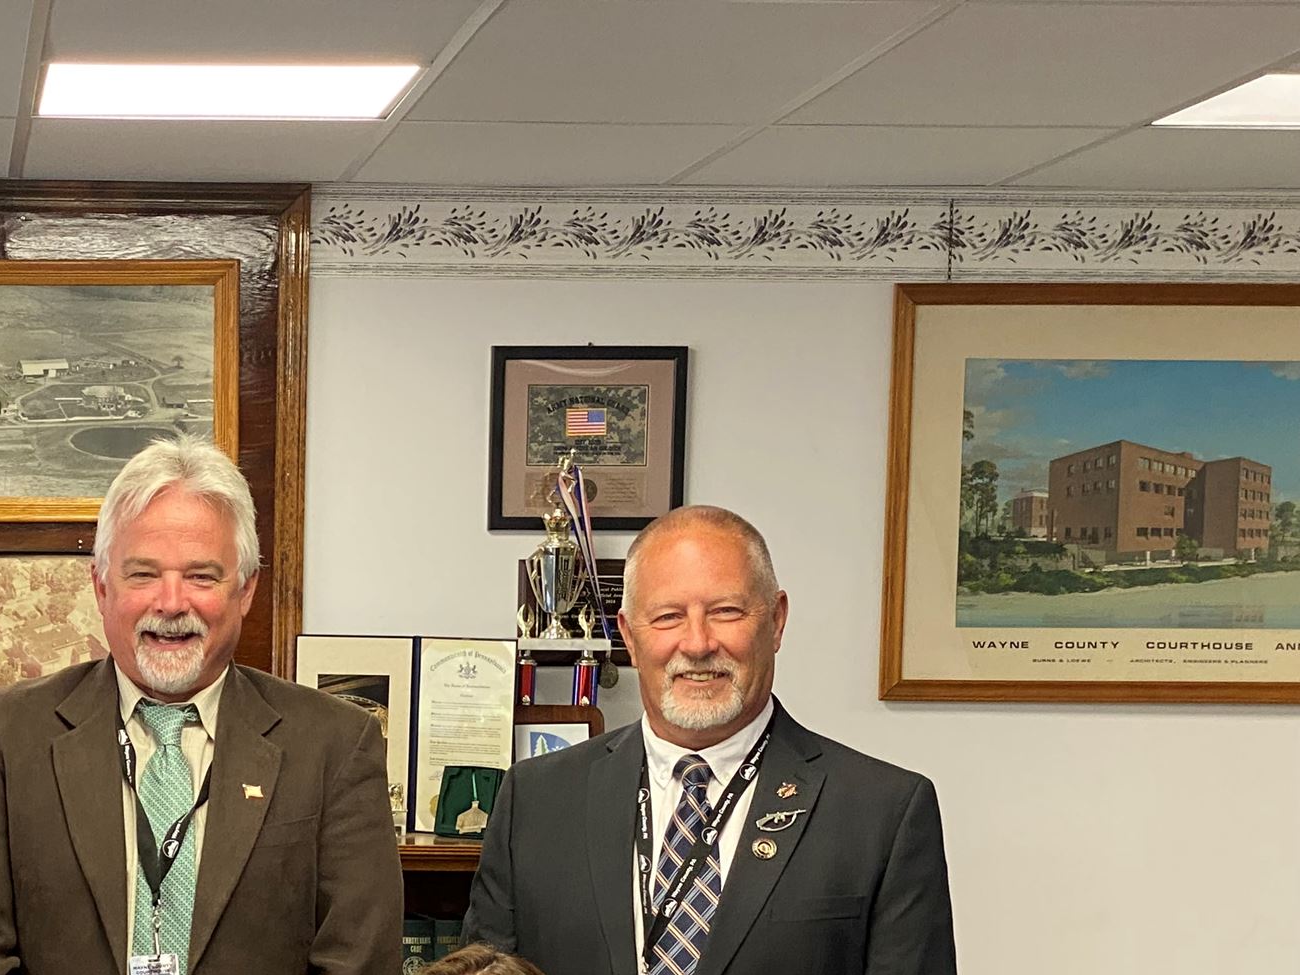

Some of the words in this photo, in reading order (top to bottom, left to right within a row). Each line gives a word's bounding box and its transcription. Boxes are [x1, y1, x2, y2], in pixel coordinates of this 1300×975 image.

[972, 640, 1029, 649] WAYNE
[1053, 640, 1120, 650] COUNTY
[1145, 641, 1254, 651] COURTHOUSE
[711, 813, 723, 828] Wayne
[671, 882, 683, 898] Wayne
